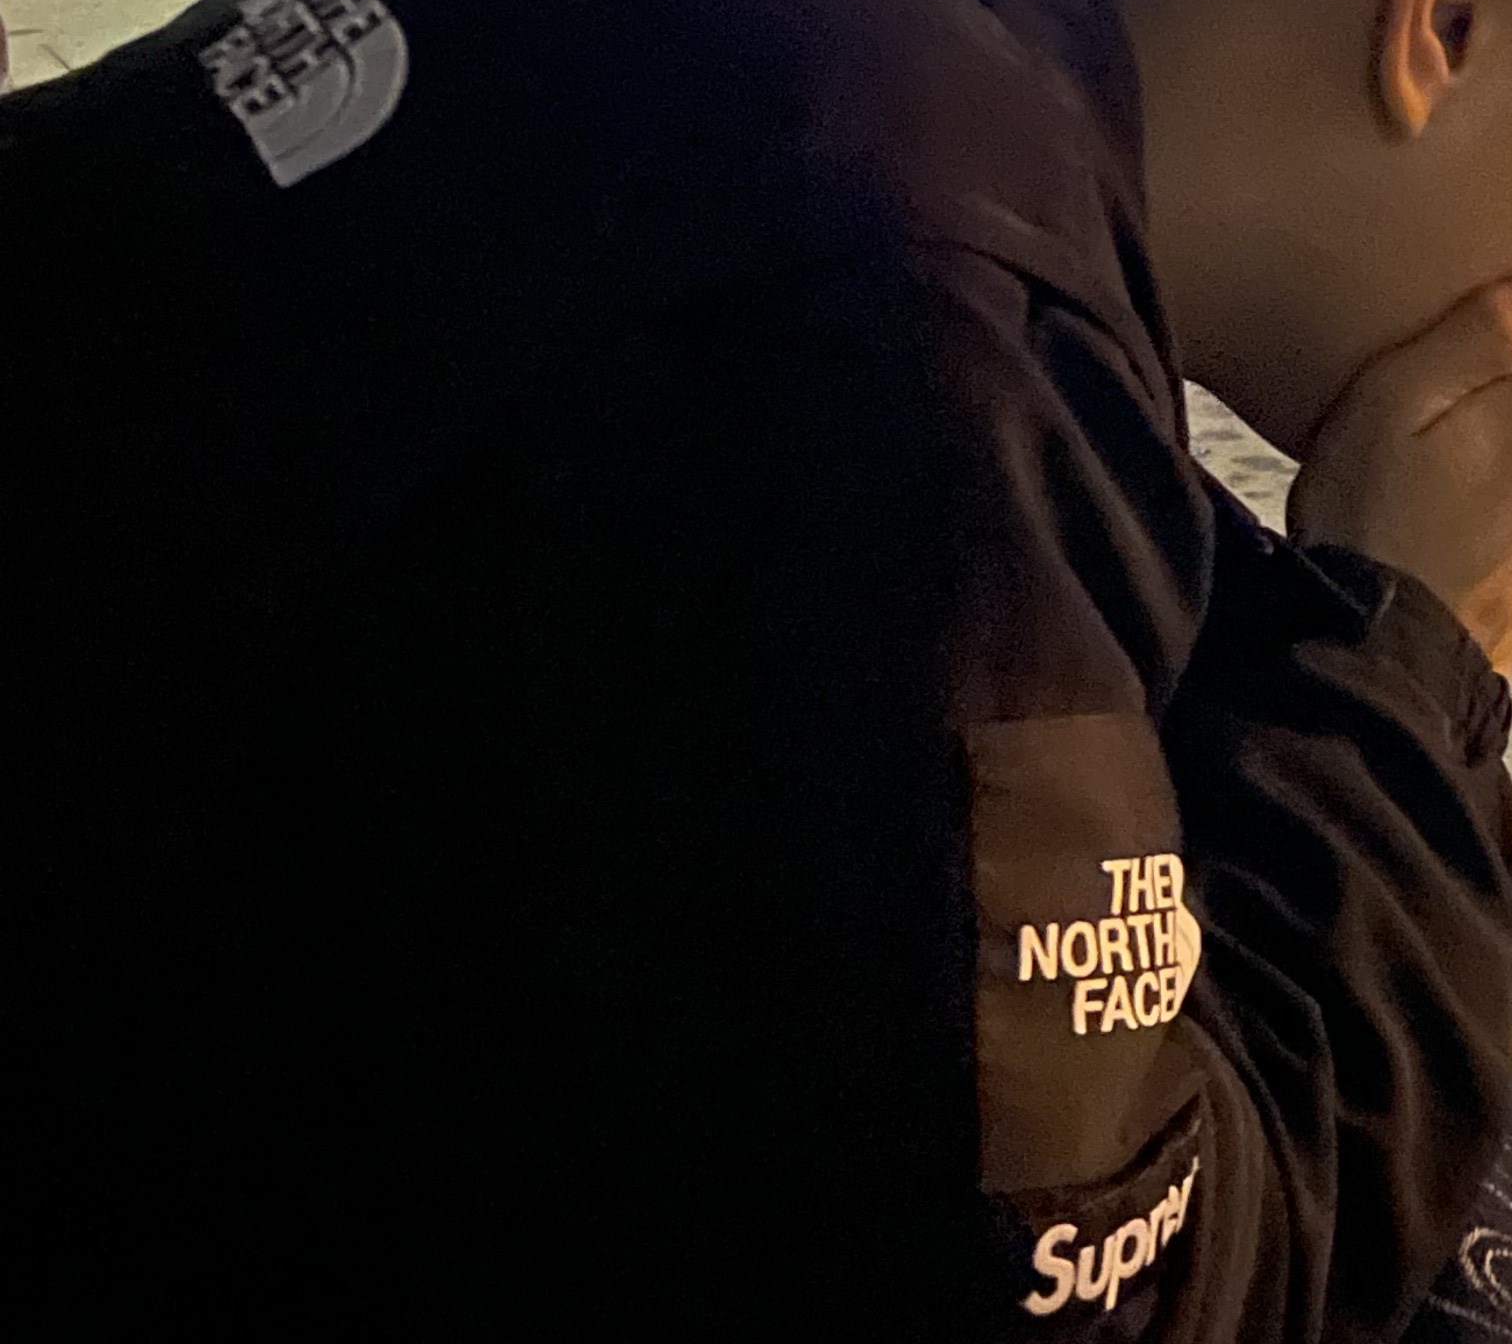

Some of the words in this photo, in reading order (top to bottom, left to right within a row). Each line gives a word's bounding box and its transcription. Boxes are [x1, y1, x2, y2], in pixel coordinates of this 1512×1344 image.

[1102, 854, 1178, 915] THE
[1019, 908, 1177, 982] NORTH
[1073, 968, 1178, 1035] FACE
